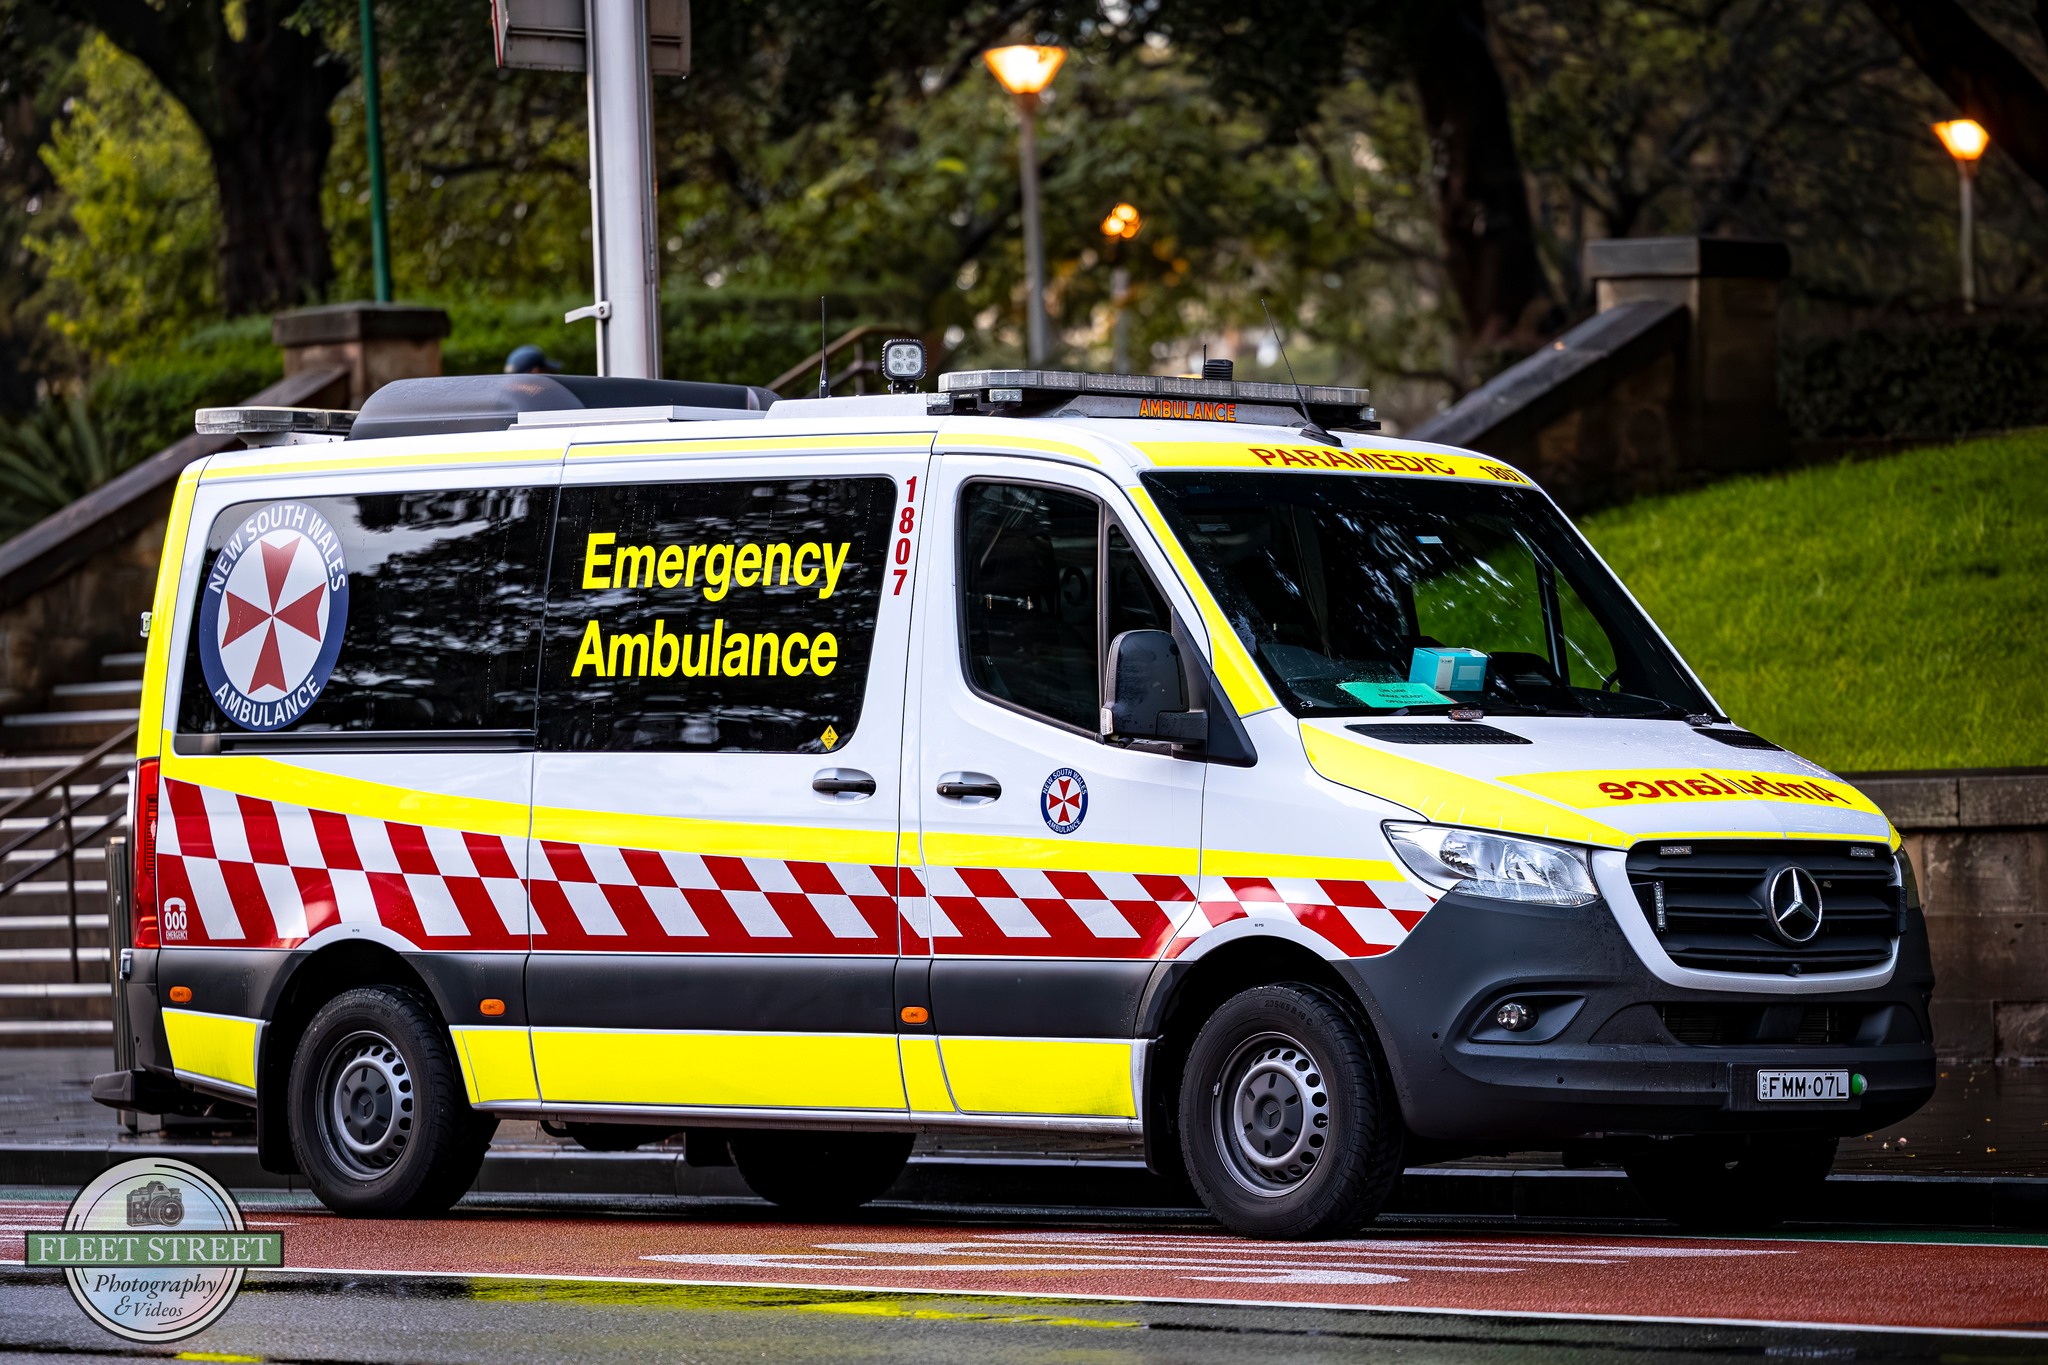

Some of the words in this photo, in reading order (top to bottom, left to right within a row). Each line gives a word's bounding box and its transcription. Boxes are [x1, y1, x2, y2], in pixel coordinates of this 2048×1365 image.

[1138, 398, 1237, 422] AMBULANCE
[1247, 447, 1456, 476] PARAMEDIC
[208, 532, 244, 595] NEW
[245, 504, 308, 541] SOUTH
[306, 512, 347, 593] WALES
[892, 475, 918, 597] 1807
[581, 531, 852, 603] Emergency
[570, 618, 840, 678] Ambulance
[214, 674, 321, 728] AMBULANCE
[1042, 777, 1053, 794] NEW
[1052, 768, 1073, 780] SOUTH
[1073, 772, 1087, 795] WALES
[1047, 818, 1081, 833] AMBULANCE
